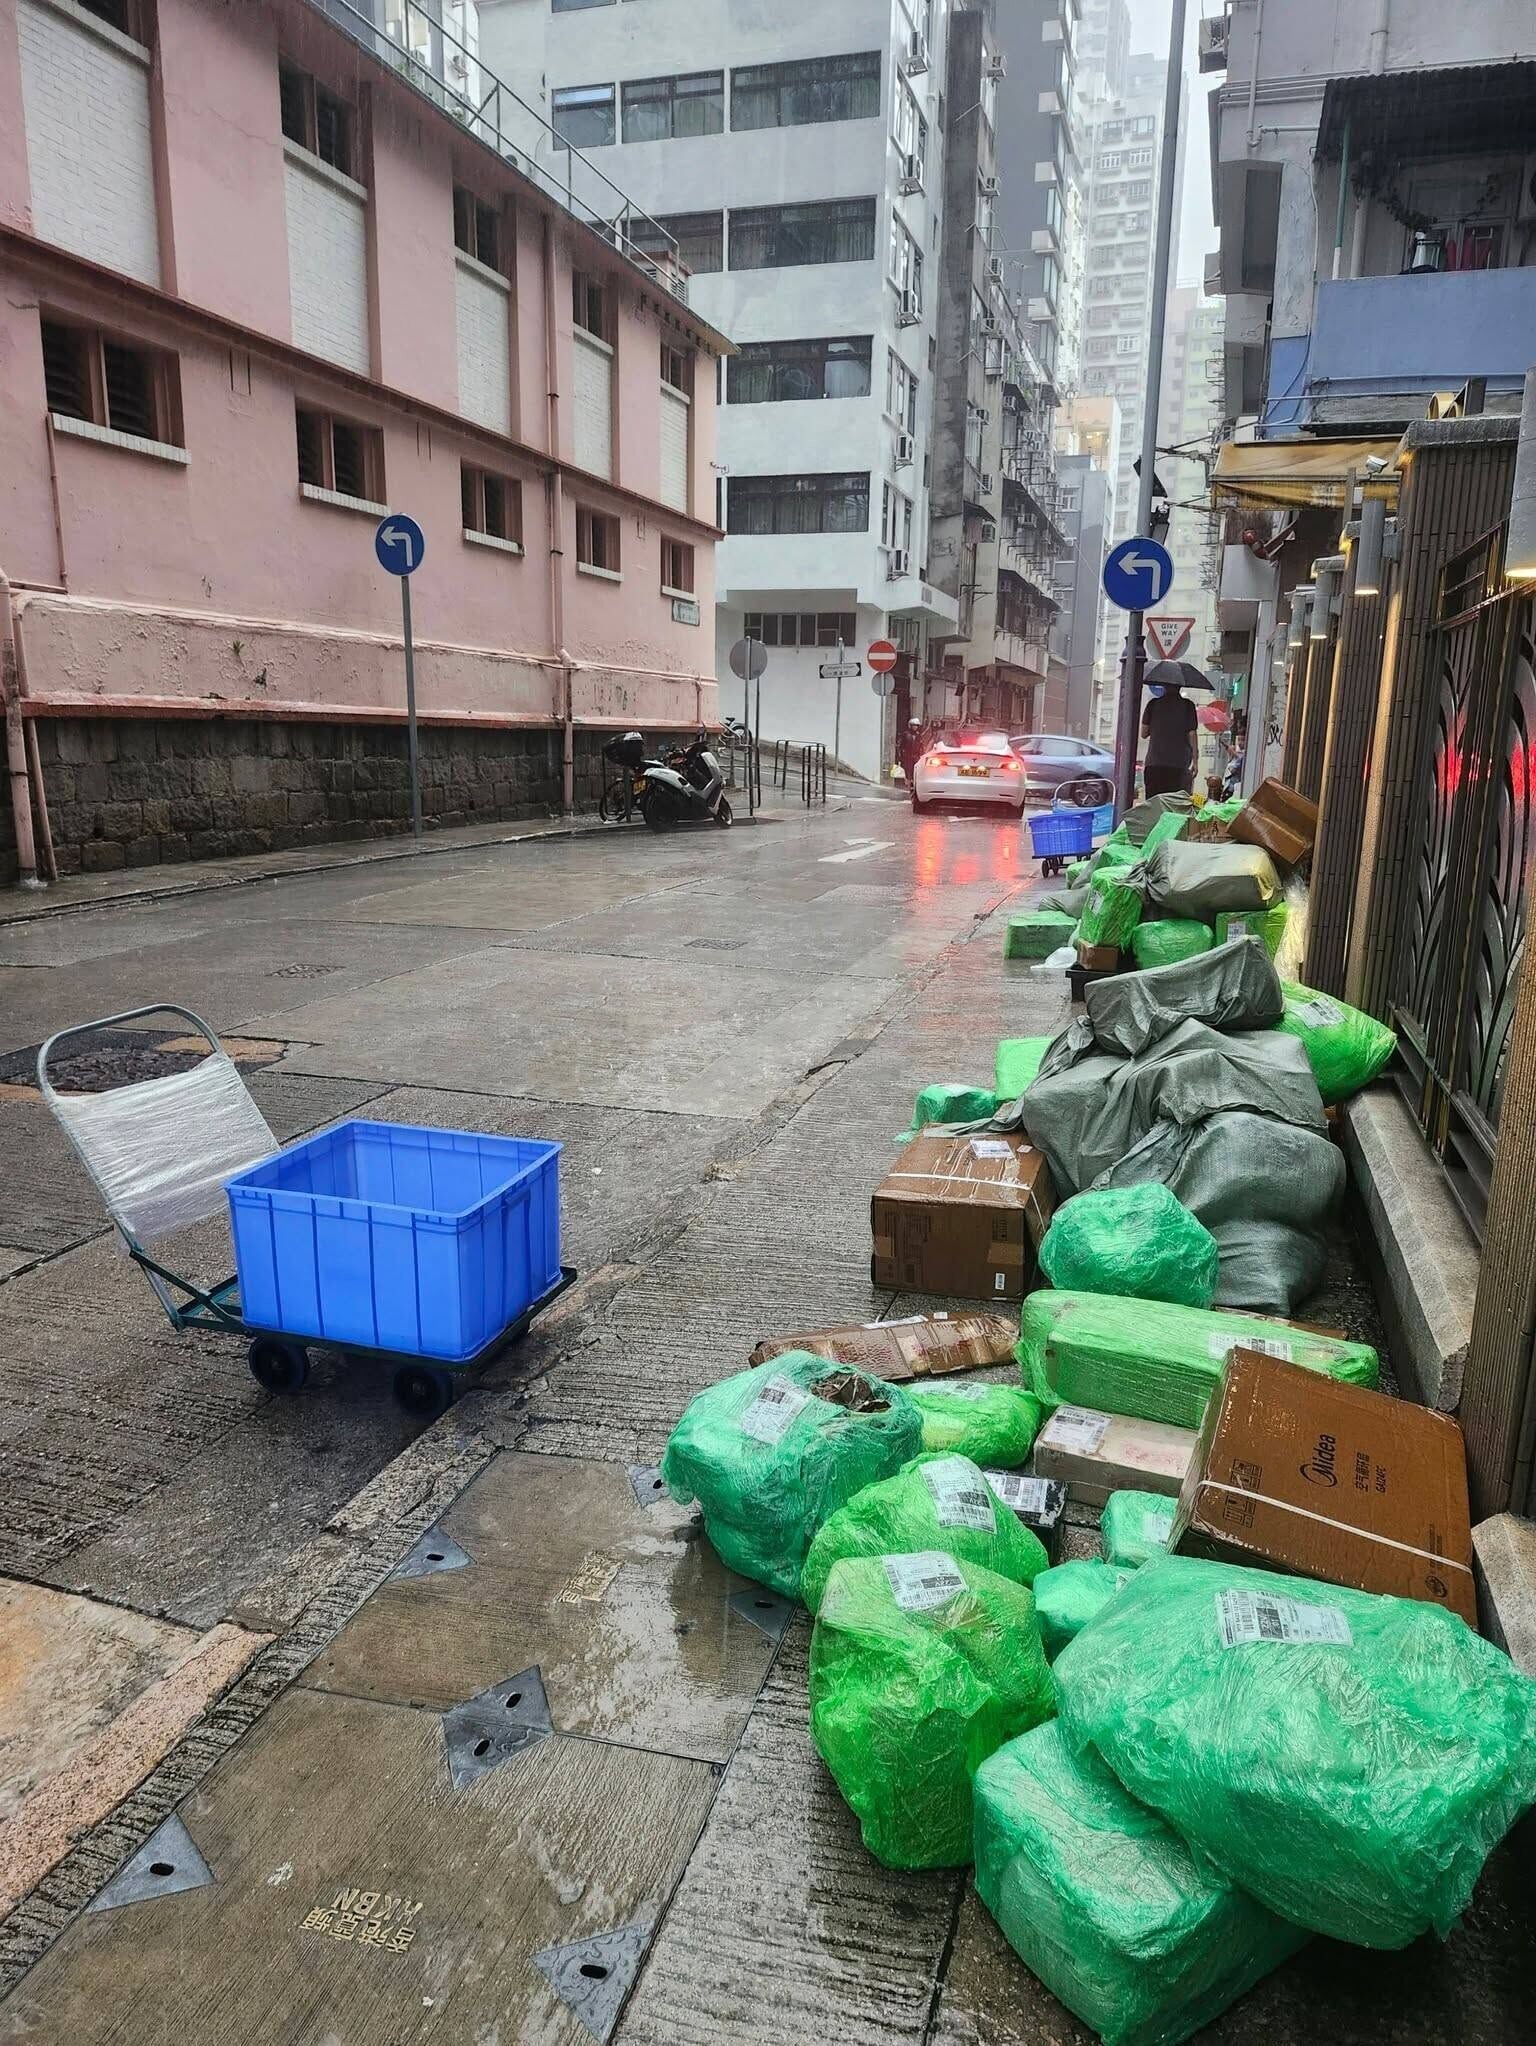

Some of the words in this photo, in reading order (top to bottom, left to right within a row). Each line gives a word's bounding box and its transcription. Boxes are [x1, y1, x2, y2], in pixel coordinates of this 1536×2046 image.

[1300, 1434, 1338, 1488] Midea
[300, 1906, 416, 1953] 香港寬頻
[331, 1888, 423, 1925] HKBN
